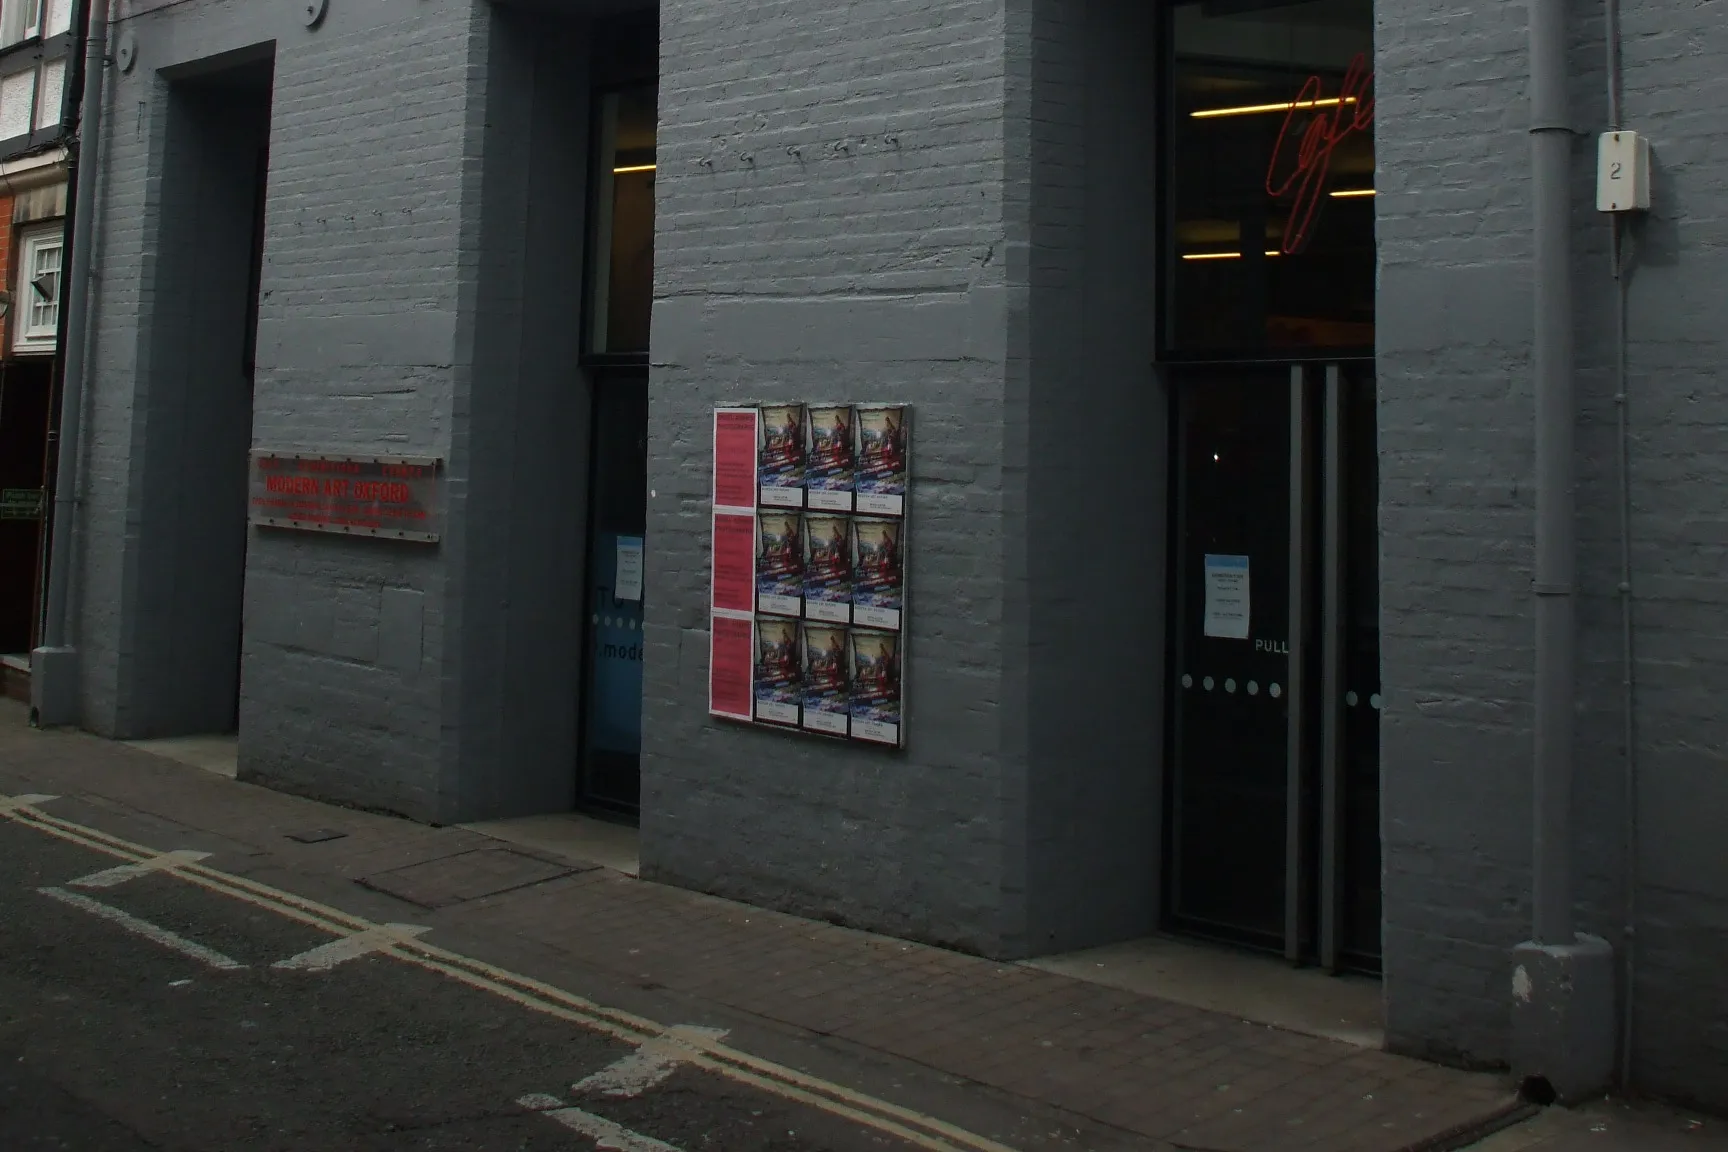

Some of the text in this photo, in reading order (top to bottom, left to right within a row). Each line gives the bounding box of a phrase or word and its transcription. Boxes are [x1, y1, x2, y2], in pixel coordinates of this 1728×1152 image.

[1610, 162, 1621, 180] 2
[266, 475, 408, 503] MODERN ART OXFORD
[1255, 638, 1289, 654] PULL
